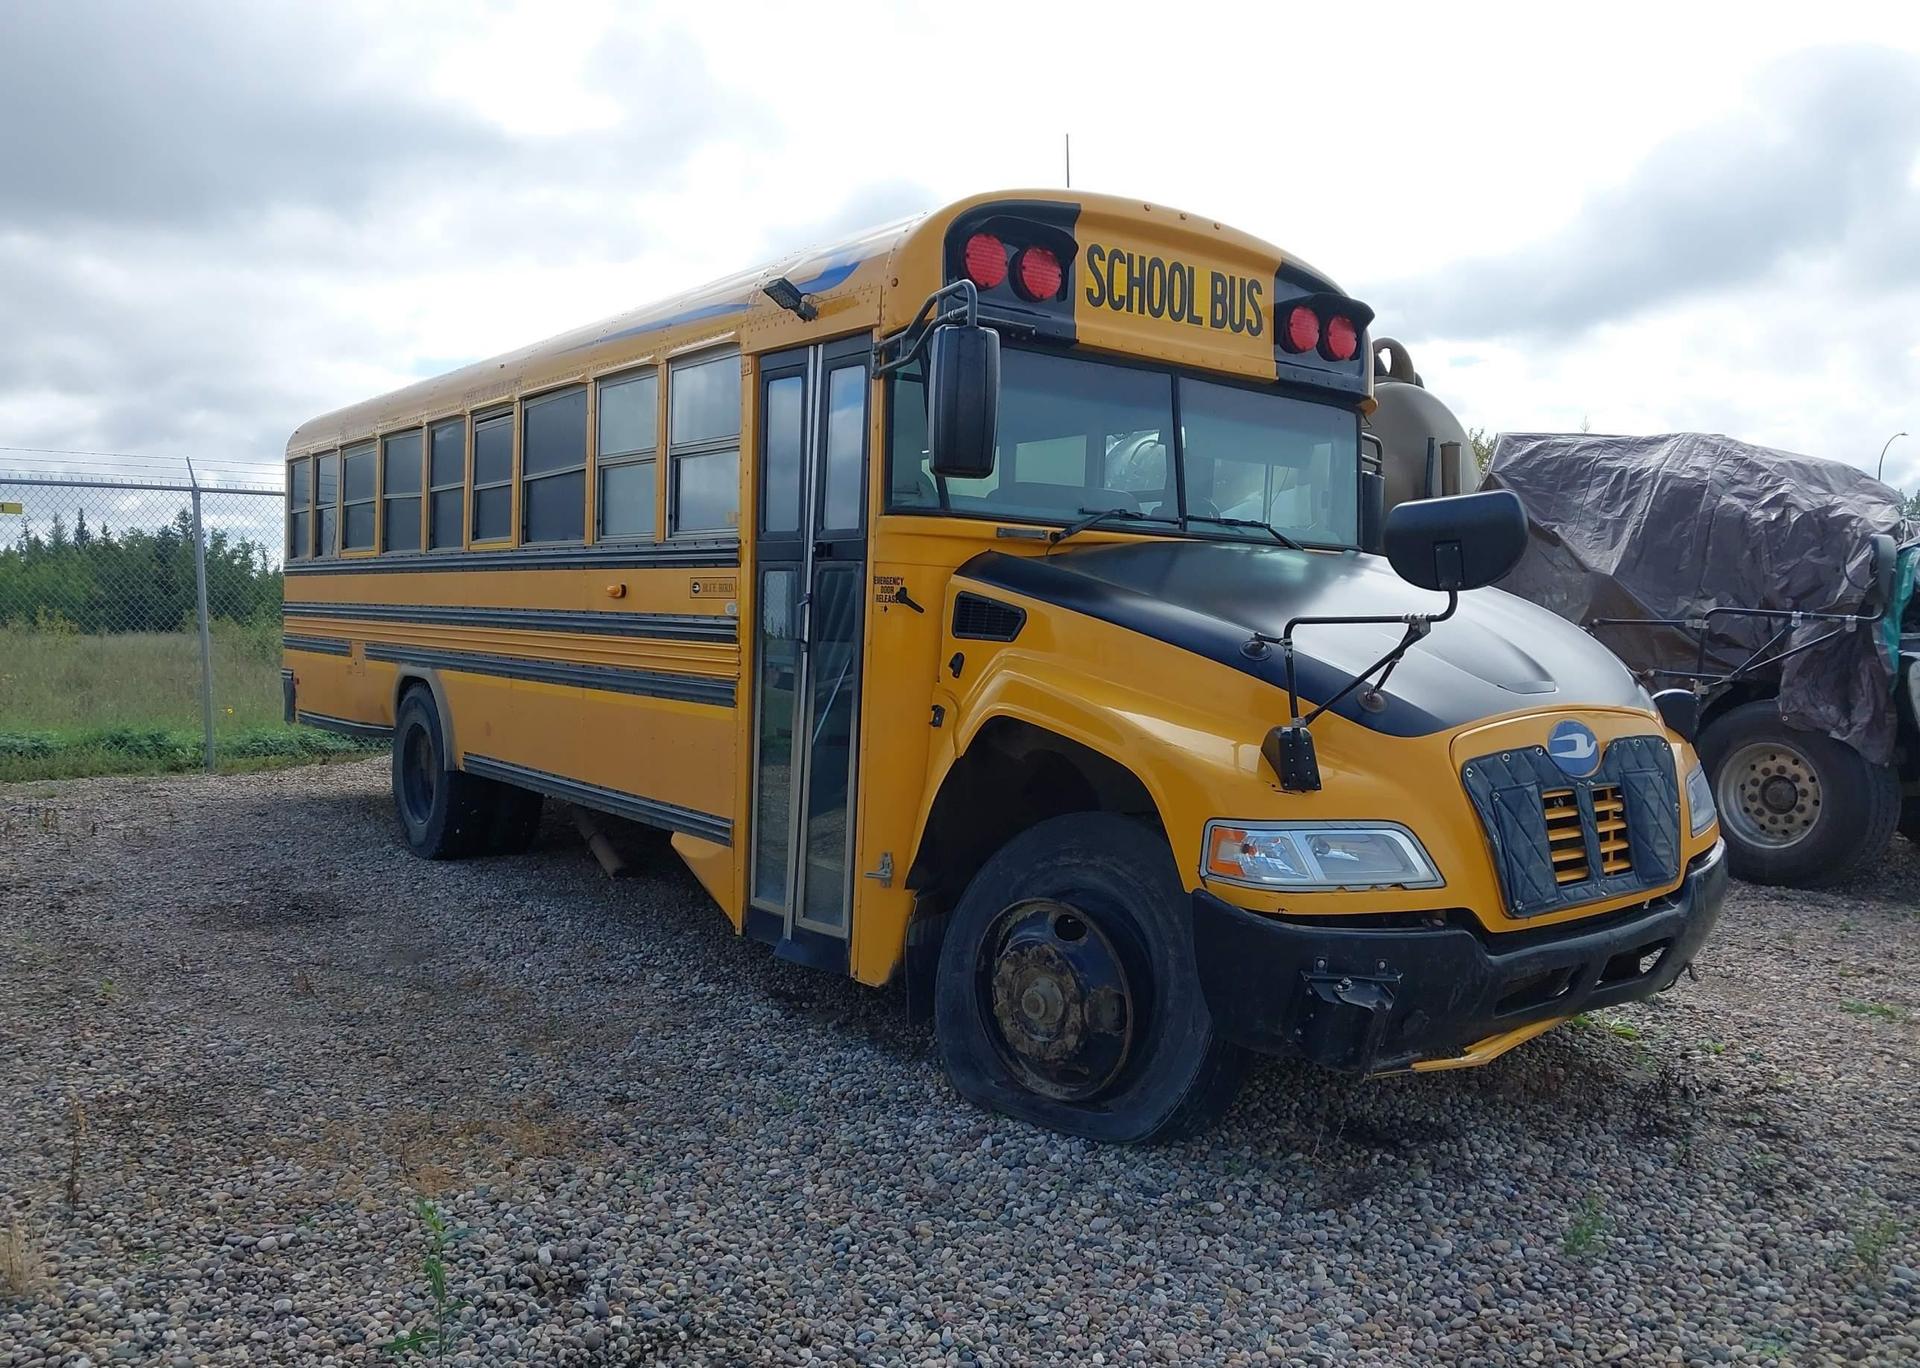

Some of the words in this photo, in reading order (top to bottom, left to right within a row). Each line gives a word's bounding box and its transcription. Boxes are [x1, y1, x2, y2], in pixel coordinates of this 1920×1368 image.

[1086, 243, 1203, 326] SCHOOL
[1210, 271, 1263, 337] BUS
[873, 576, 904, 585] EMERGENCY
[881, 585, 894, 594] DOOR
